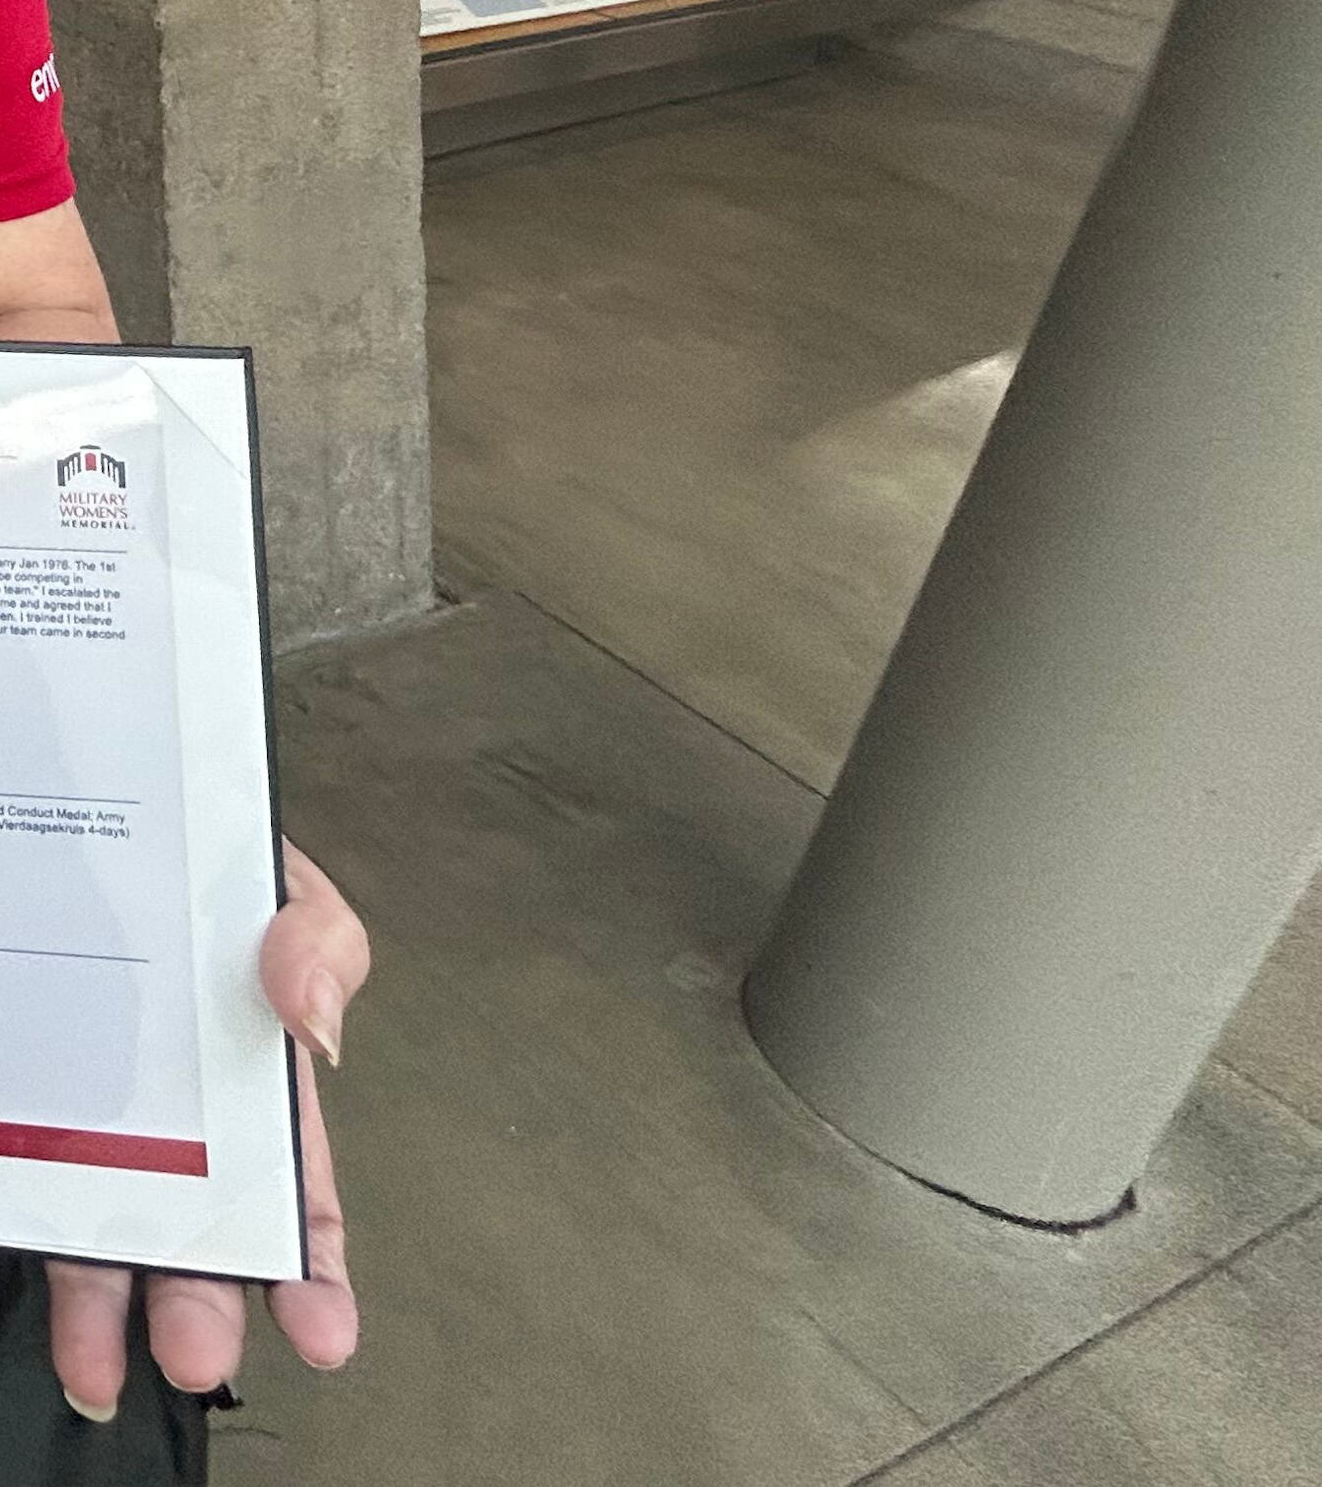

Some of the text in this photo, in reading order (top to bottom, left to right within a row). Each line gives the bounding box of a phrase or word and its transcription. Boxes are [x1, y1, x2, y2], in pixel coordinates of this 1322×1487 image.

[58, 493, 127, 505] MILITARY
[59, 505, 128, 518] WOMEN'S
[7, 804, 54, 817] Conduct
[95, 809, 125, 823] Army
